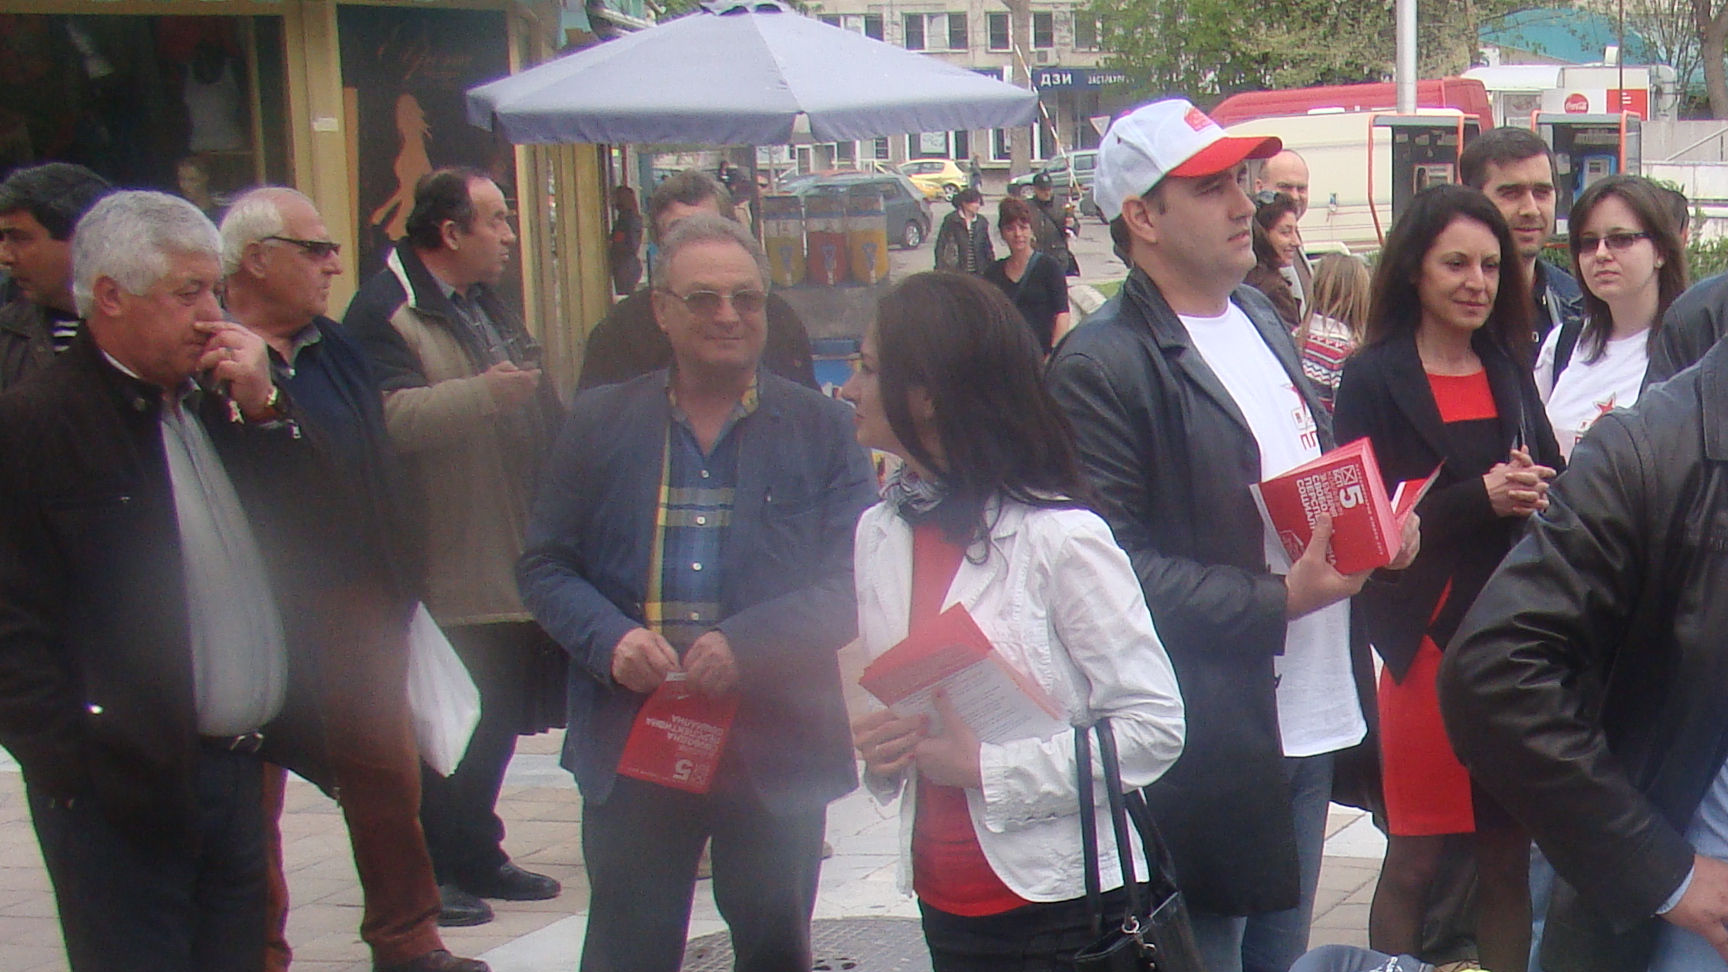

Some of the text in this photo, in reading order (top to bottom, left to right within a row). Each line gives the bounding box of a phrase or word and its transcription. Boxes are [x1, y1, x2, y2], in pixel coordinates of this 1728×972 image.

[1040, 73, 1072, 86] ДЗИ
[1332, 469, 1344, 487] БСП
[1296, 479, 1317, 530] СОЦИАЛ
[1339, 485, 1364, 508] 5
[672, 759, 693, 780] 5
